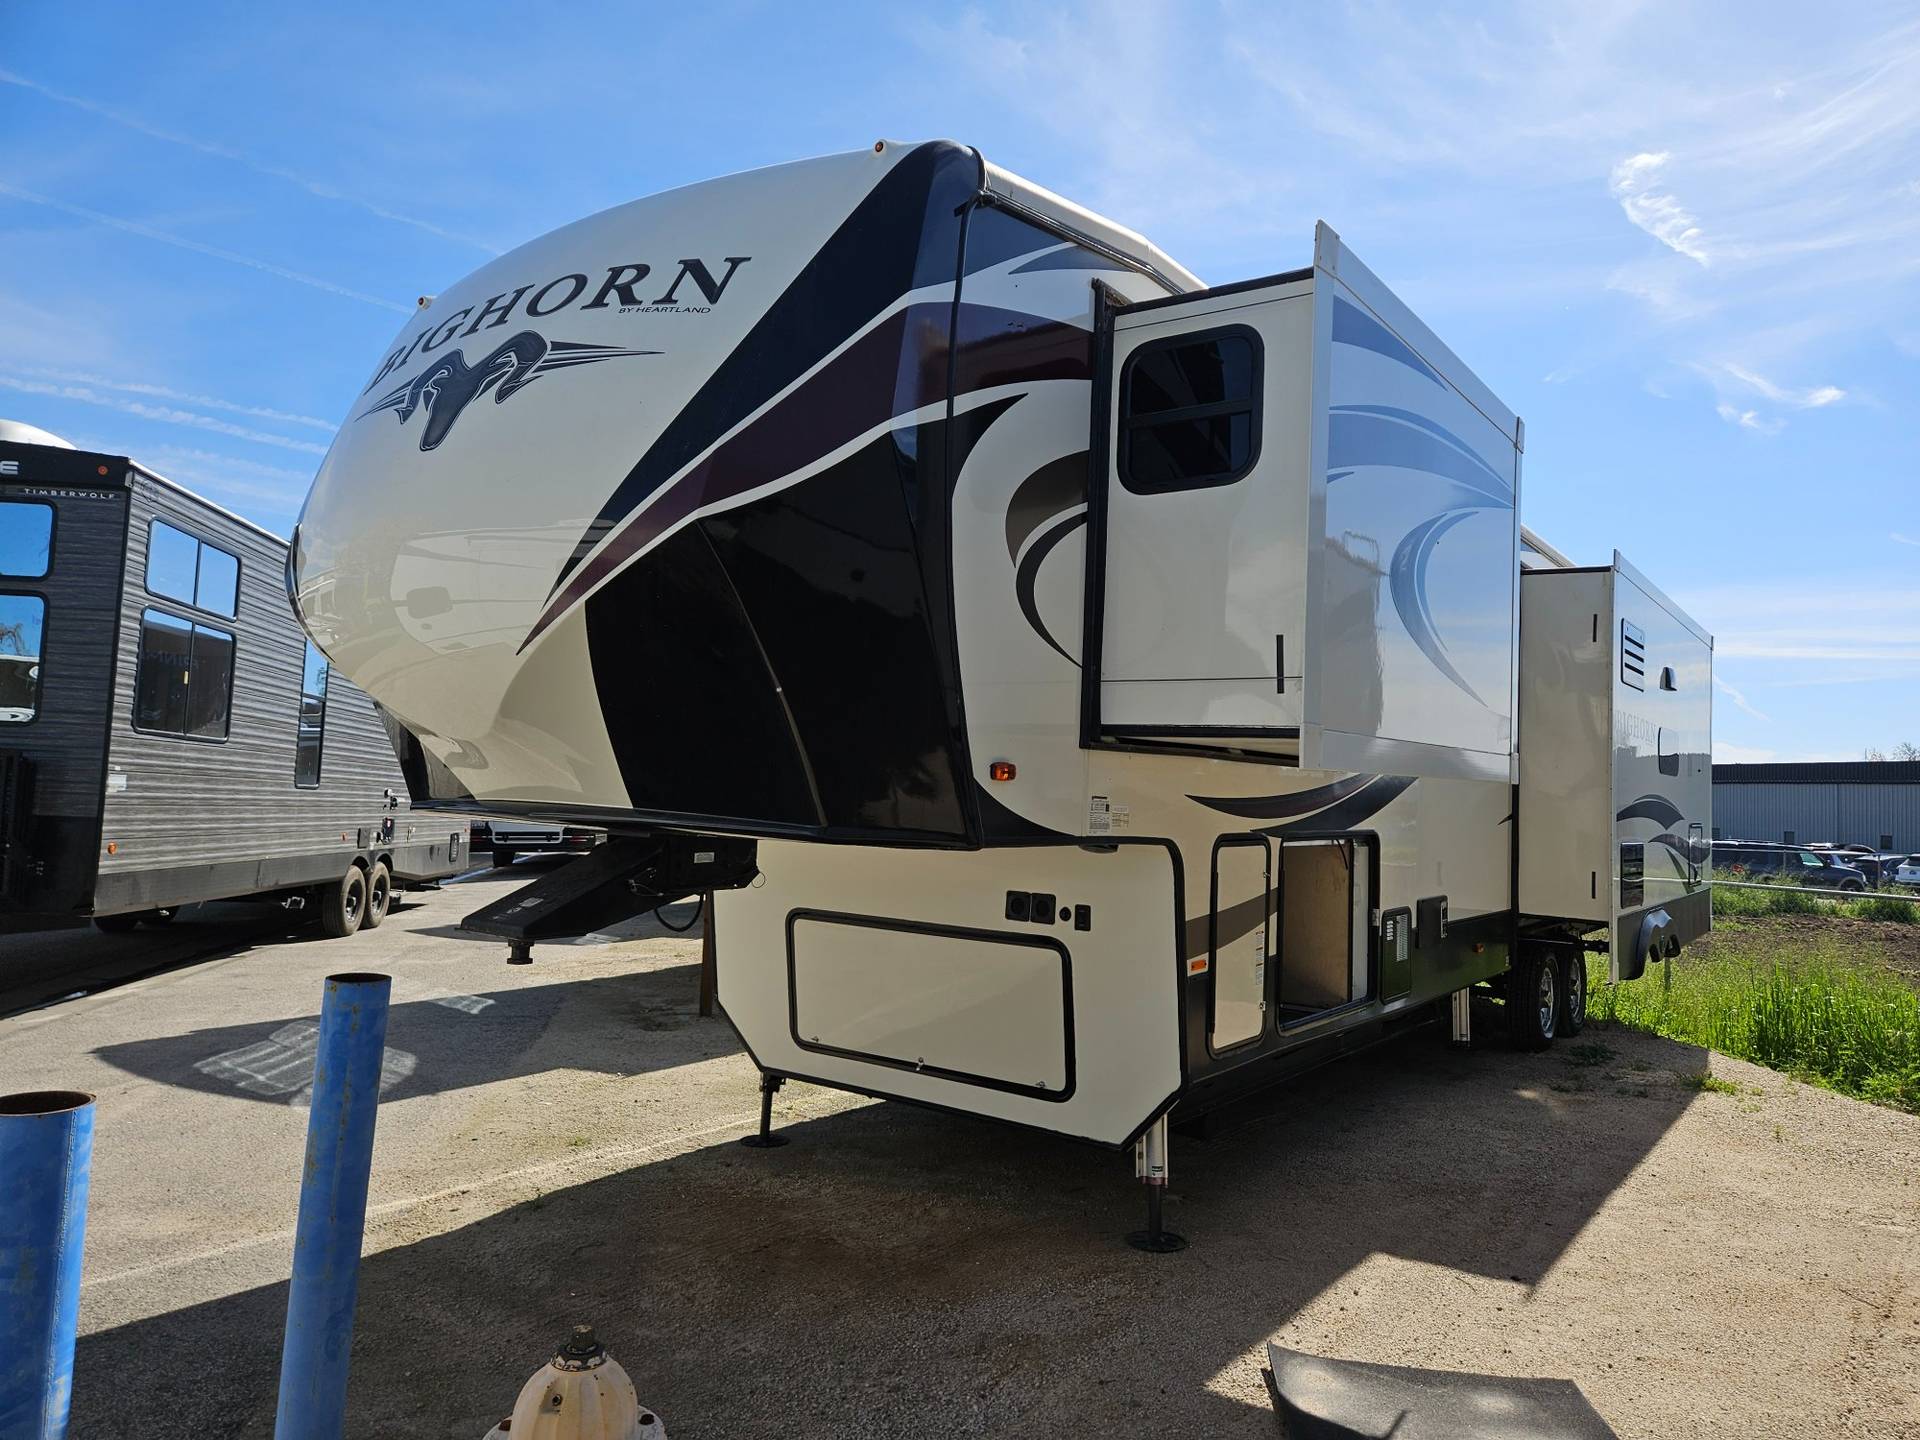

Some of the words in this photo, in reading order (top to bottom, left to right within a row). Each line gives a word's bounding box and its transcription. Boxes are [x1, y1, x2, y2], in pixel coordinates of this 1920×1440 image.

[635, 306, 712, 314] HEARTLAND
[363, 256, 752, 396] BIGHORN
[24, 488, 115, 499] TIMBERWOLF
